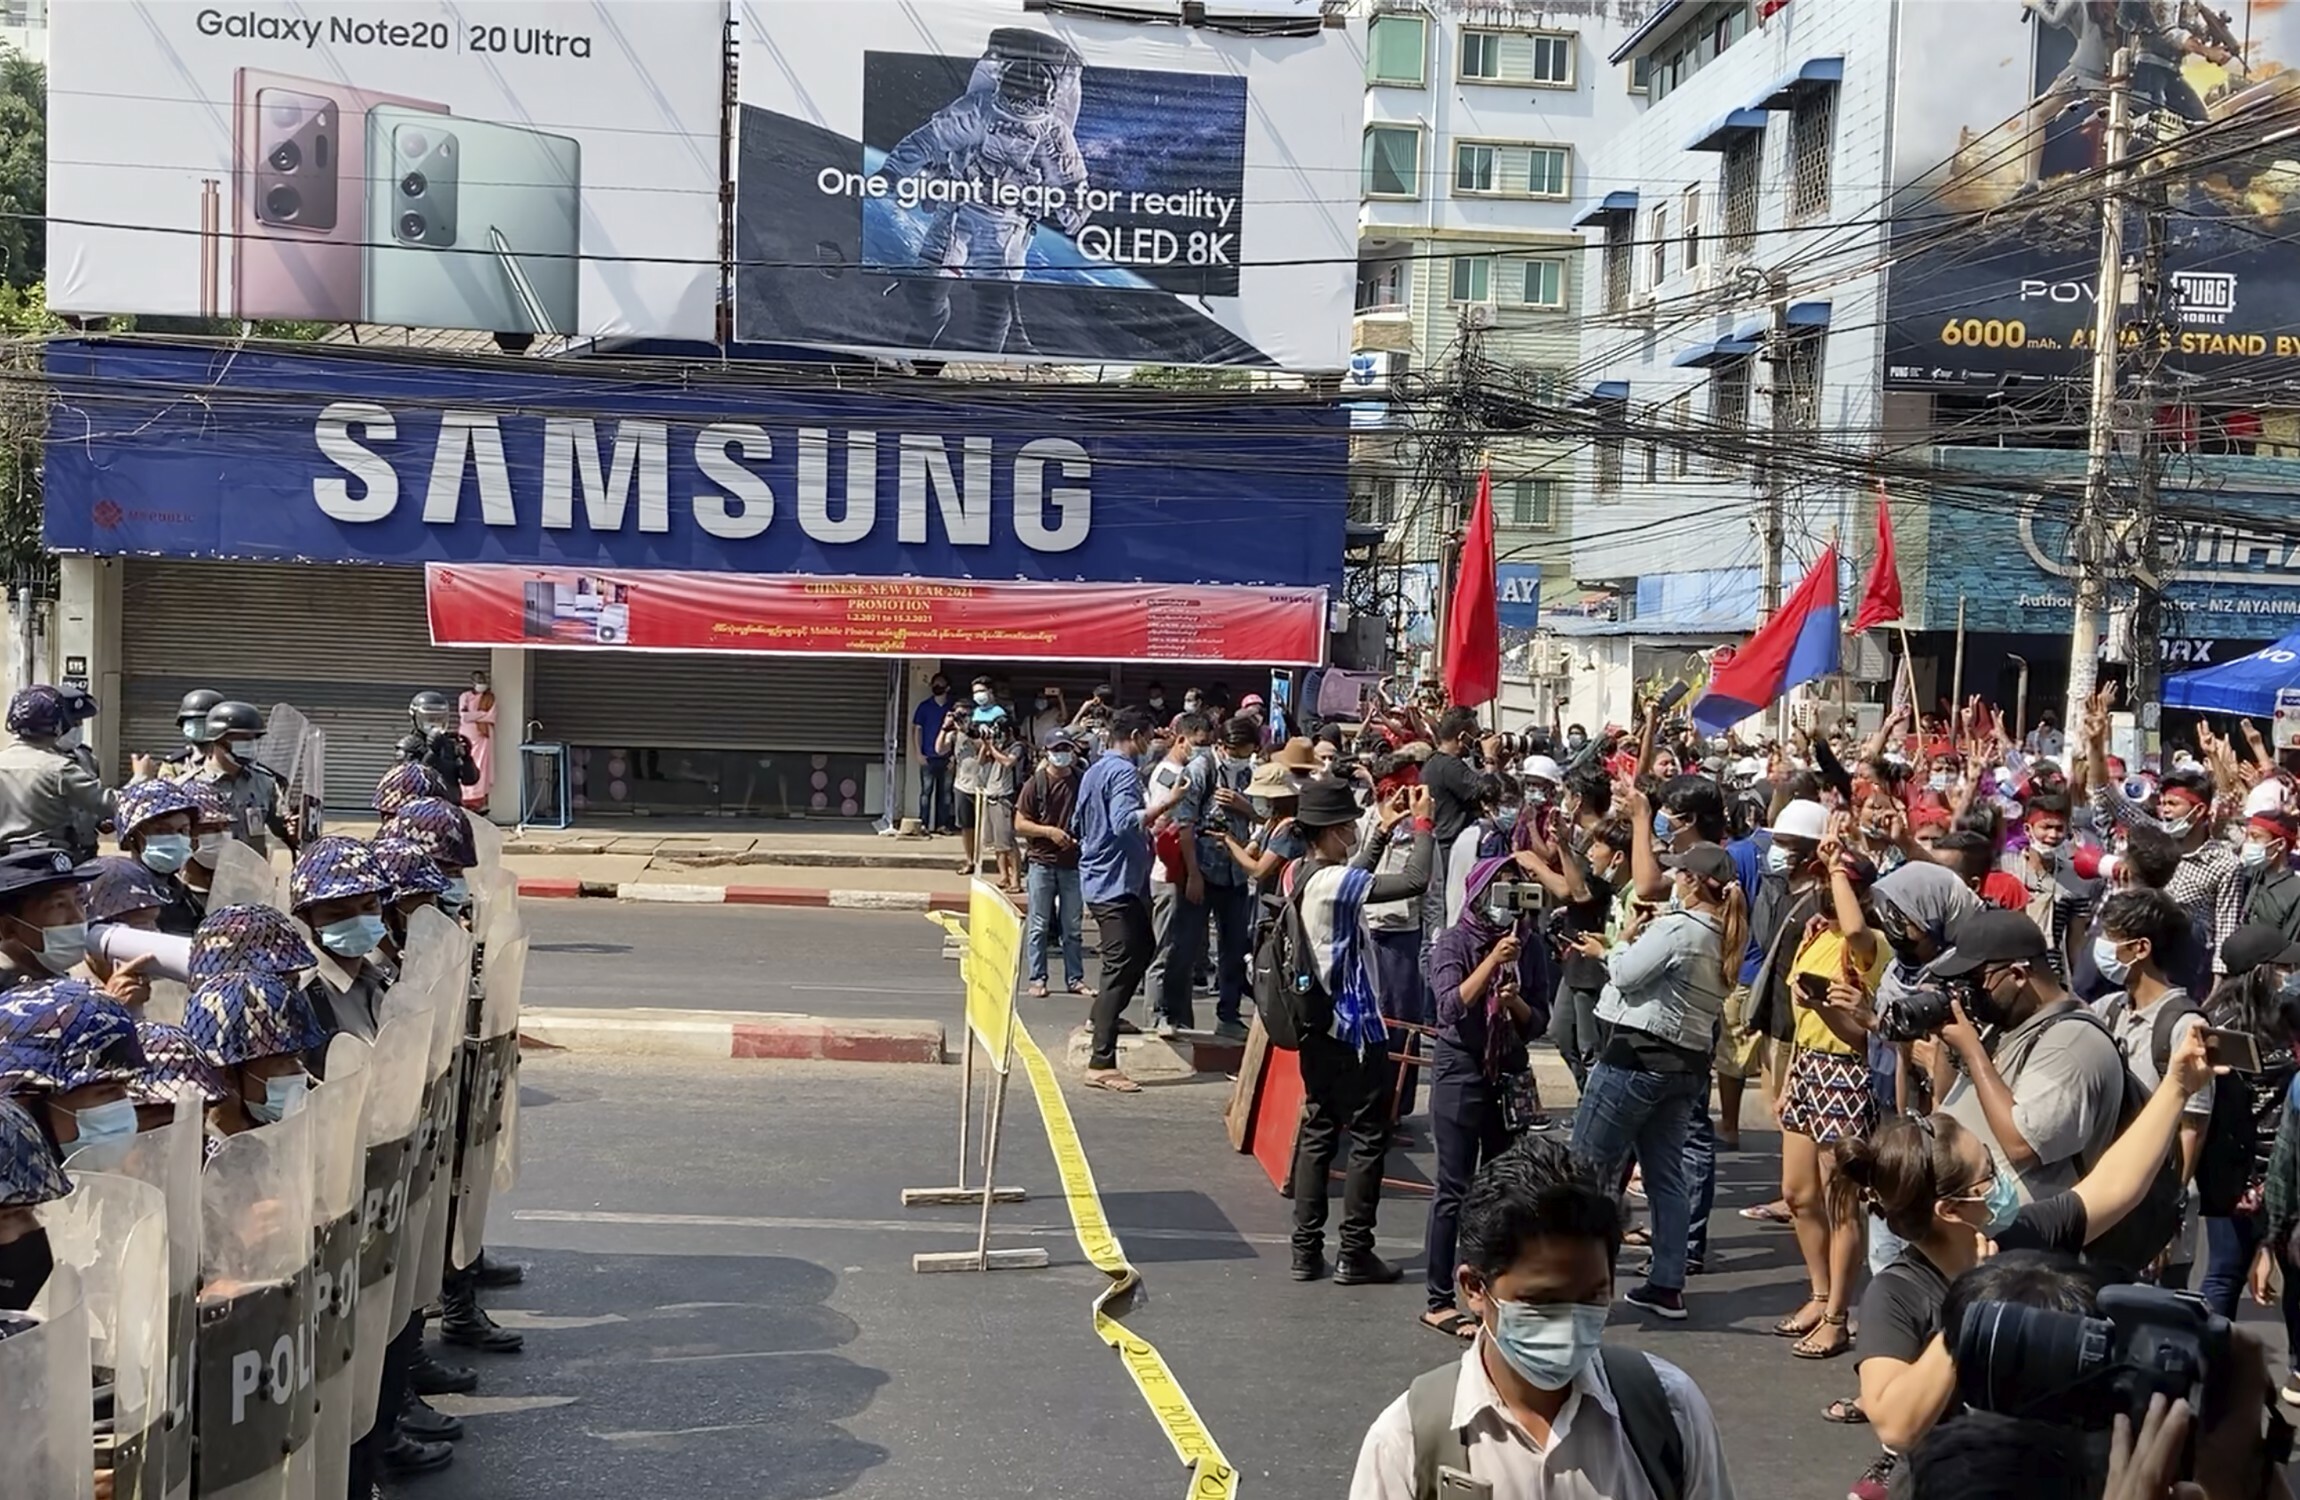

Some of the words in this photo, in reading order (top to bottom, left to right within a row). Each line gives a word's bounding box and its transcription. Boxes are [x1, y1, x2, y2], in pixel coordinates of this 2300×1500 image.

[196, 9, 321, 49] Galaxy
[329, 16, 449, 50] Note20
[469, 25, 508, 53] 20
[513, 28, 592, 60] Ultra
[817, 167, 888, 199] One
[896, 175, 985, 209] giant
[991, 180, 1067, 212] leap
[1074, 185, 1124, 213] for
[1130, 186, 1236, 227] reality
[1076, 226, 1180, 264] QLED
[1186, 230, 1233, 266] 8K
[2020, 279, 2101, 303] POV
[2180, 279, 2227, 305] PUBG
[1941, 318, 2026, 349] 6000
[2179, 331, 2267, 356] STAND
[312, 400, 1094, 554] SAMSUNG
[804, 584, 866, 595] CHINESE
[870, 585, 901, 596] NEW
[904, 586, 943, 597] YEAR
[947, 587, 973, 598] 2021
[848, 599, 930, 611] PROMOTION
[1124, 1340, 1170, 1385] OLICE
[1158, 1403, 1213, 1456] POLICE
